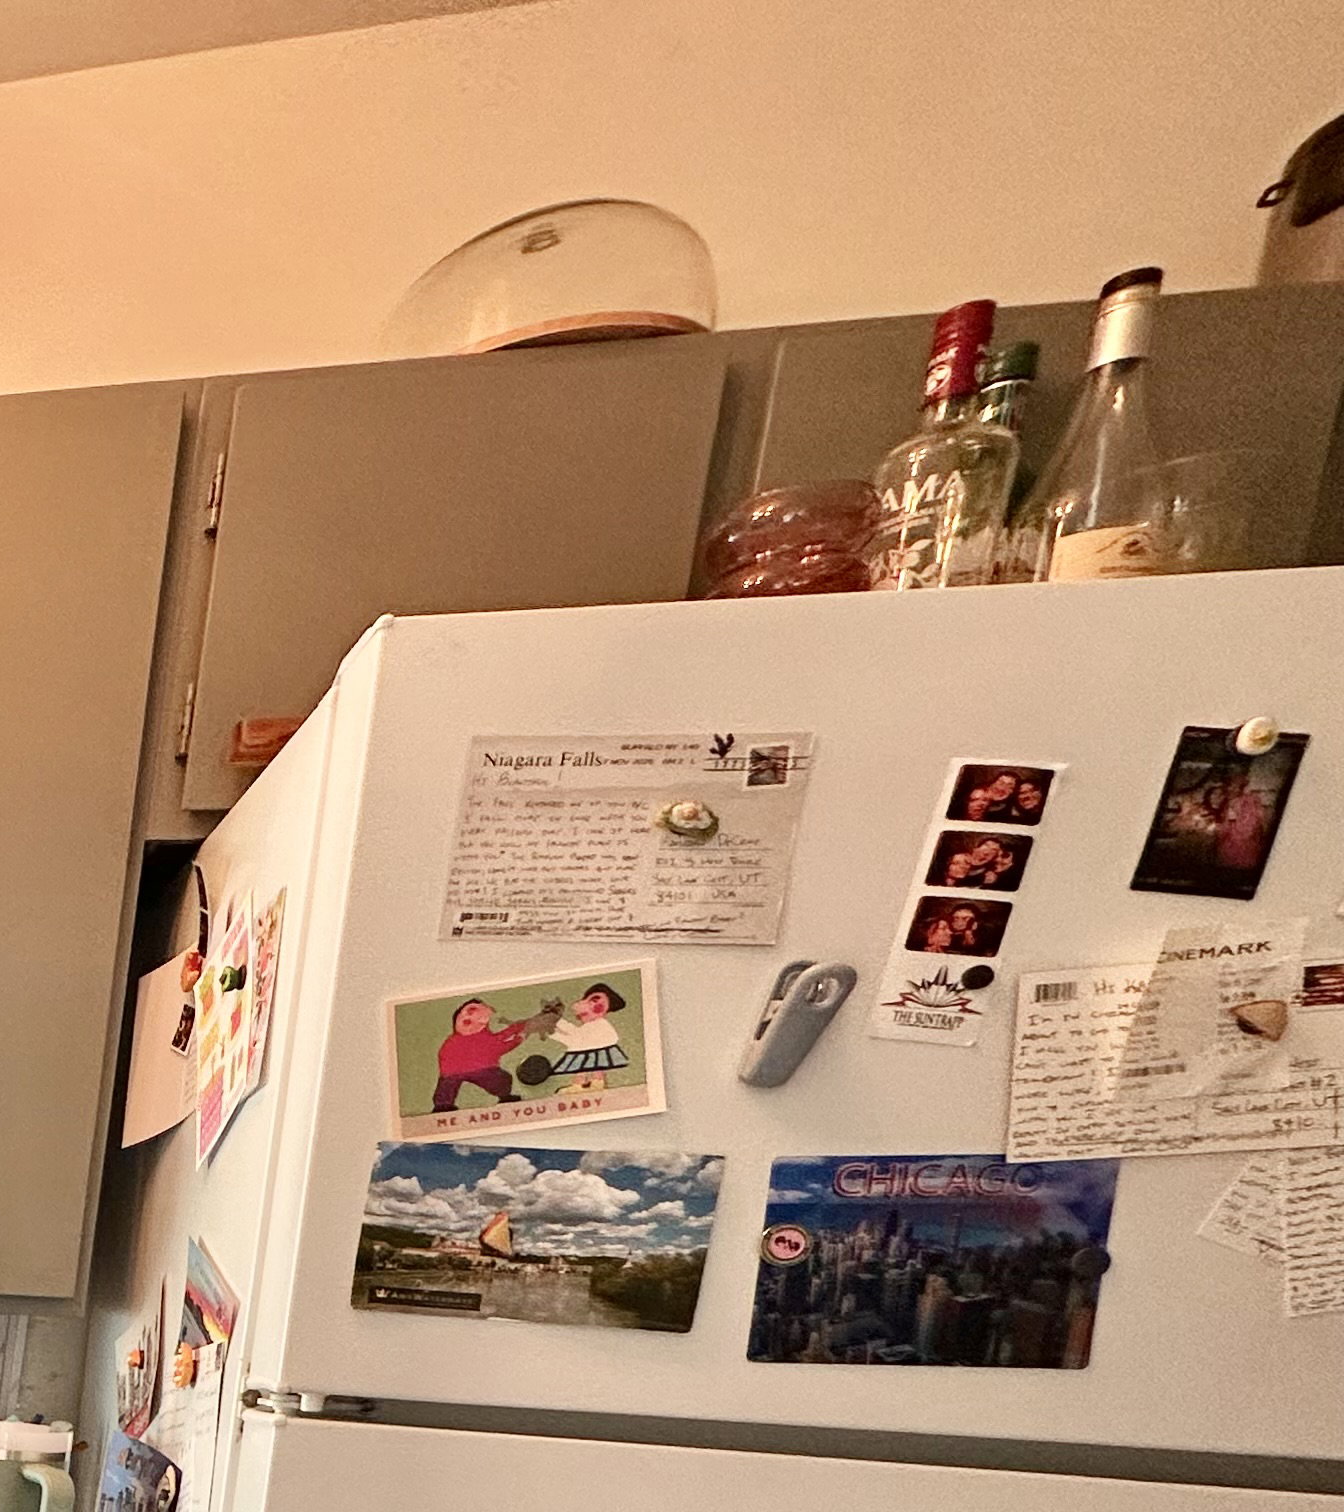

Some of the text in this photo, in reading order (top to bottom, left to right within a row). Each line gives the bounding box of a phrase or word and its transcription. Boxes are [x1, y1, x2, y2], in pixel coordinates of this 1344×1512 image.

[482, 751, 603, 771] Niagara Falls
[437, 1097, 603, 1128] ME AND YOU BABY
[831, 1161, 1044, 1198] CHICAGO
